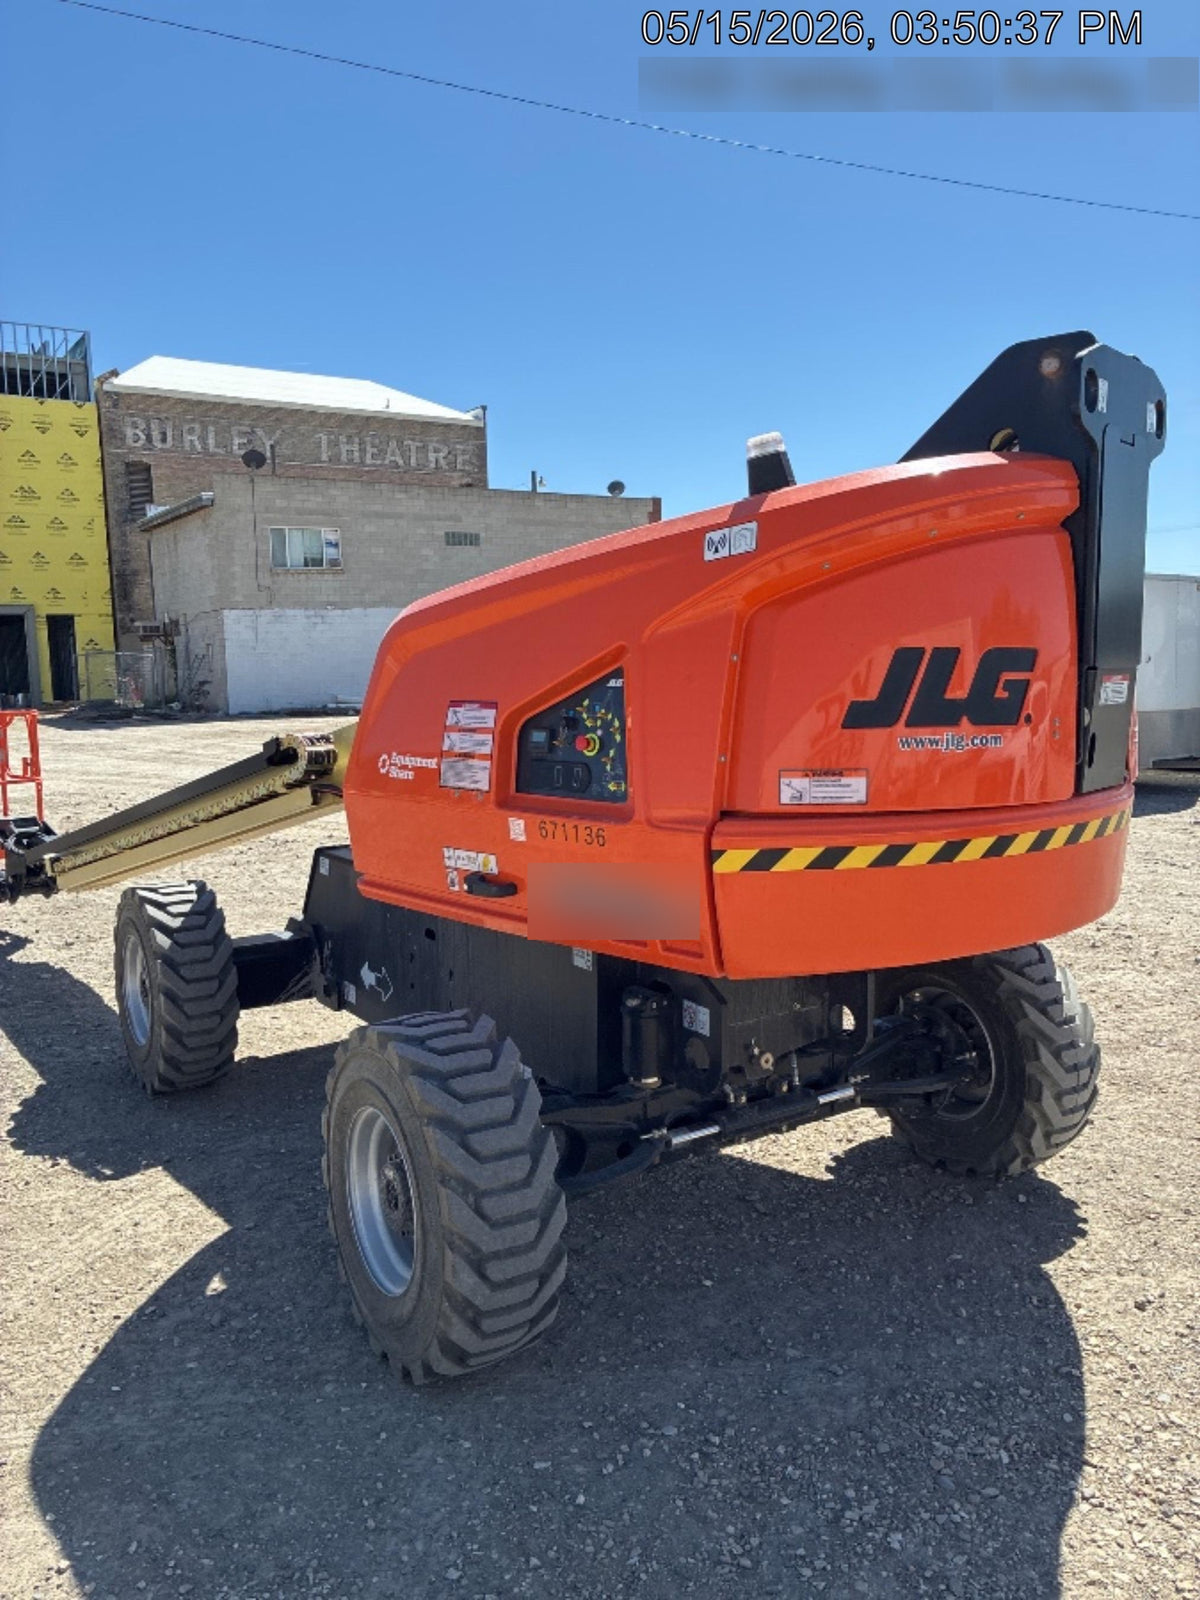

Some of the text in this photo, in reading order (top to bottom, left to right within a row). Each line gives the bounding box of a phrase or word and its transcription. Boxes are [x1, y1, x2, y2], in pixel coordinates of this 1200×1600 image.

[123, 416, 476, 472] BURLEY THEATRE
[898, 732, 1003, 751] www.jlg.com
[538, 821, 606, 847] 671136
